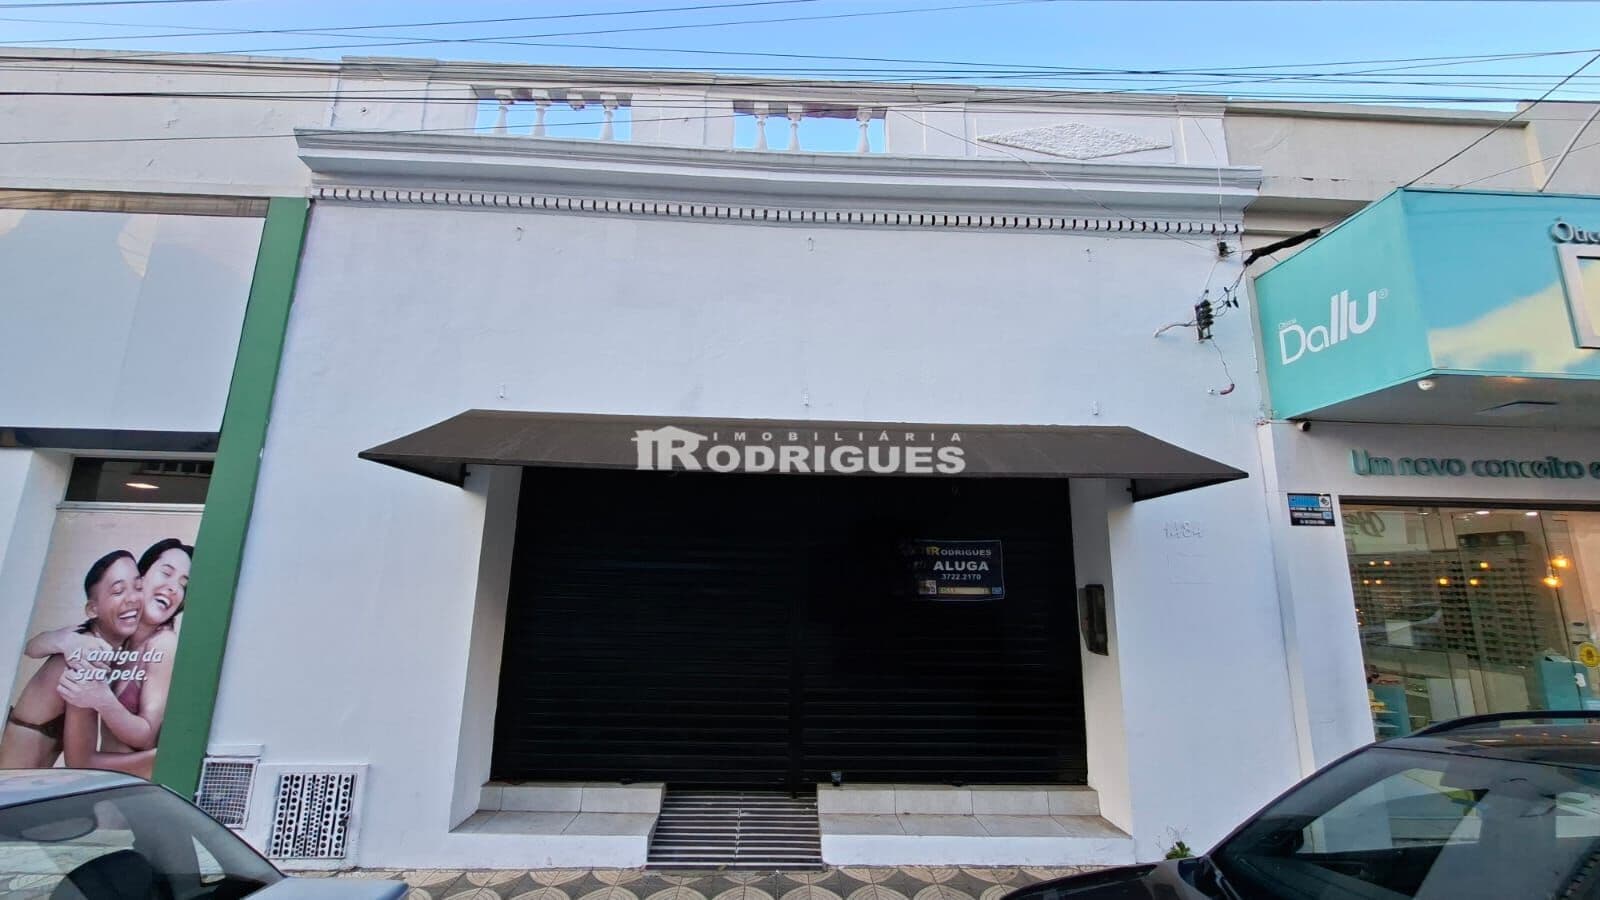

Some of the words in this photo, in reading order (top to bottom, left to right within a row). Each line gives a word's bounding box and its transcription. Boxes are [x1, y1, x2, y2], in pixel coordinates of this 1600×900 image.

[1280, 290, 1377, 365] Dallu
[1351, 449, 1393, 476] Um
[1400, 457, 1466, 476] novo
[1471, 456, 1585, 478] conceito
[933, 561, 989, 571] ALUGA
[69, 649, 82, 661] A
[87, 646, 139, 664] amiga
[143, 648, 163, 661] da
[75, 668, 107, 680] sua
[108, 666, 148, 684] pele.
